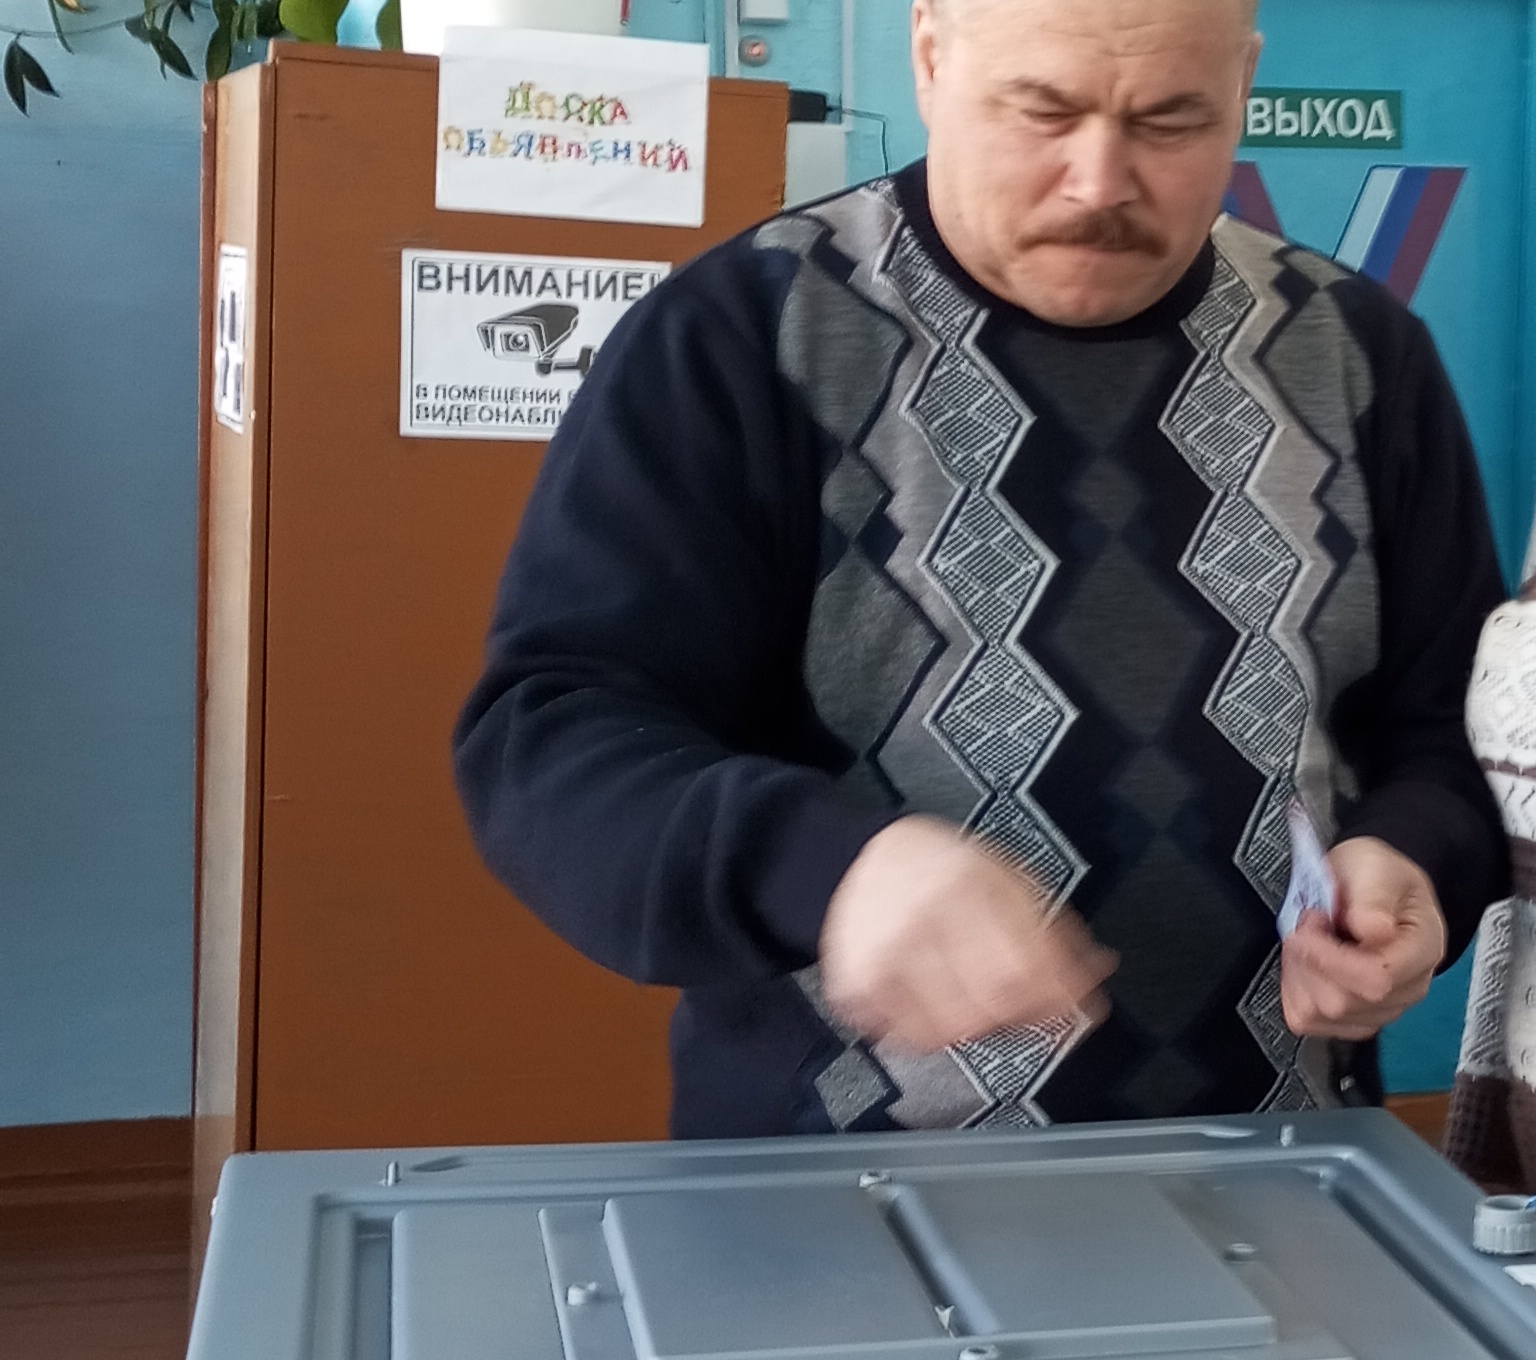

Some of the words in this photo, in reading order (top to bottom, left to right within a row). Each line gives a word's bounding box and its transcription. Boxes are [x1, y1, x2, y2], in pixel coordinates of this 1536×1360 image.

[1246, 96, 1395, 141] ВЫХОД
[416, 384, 428, 399] В
[434, 385, 561, 405] ПОМЕЩЕНИИ
